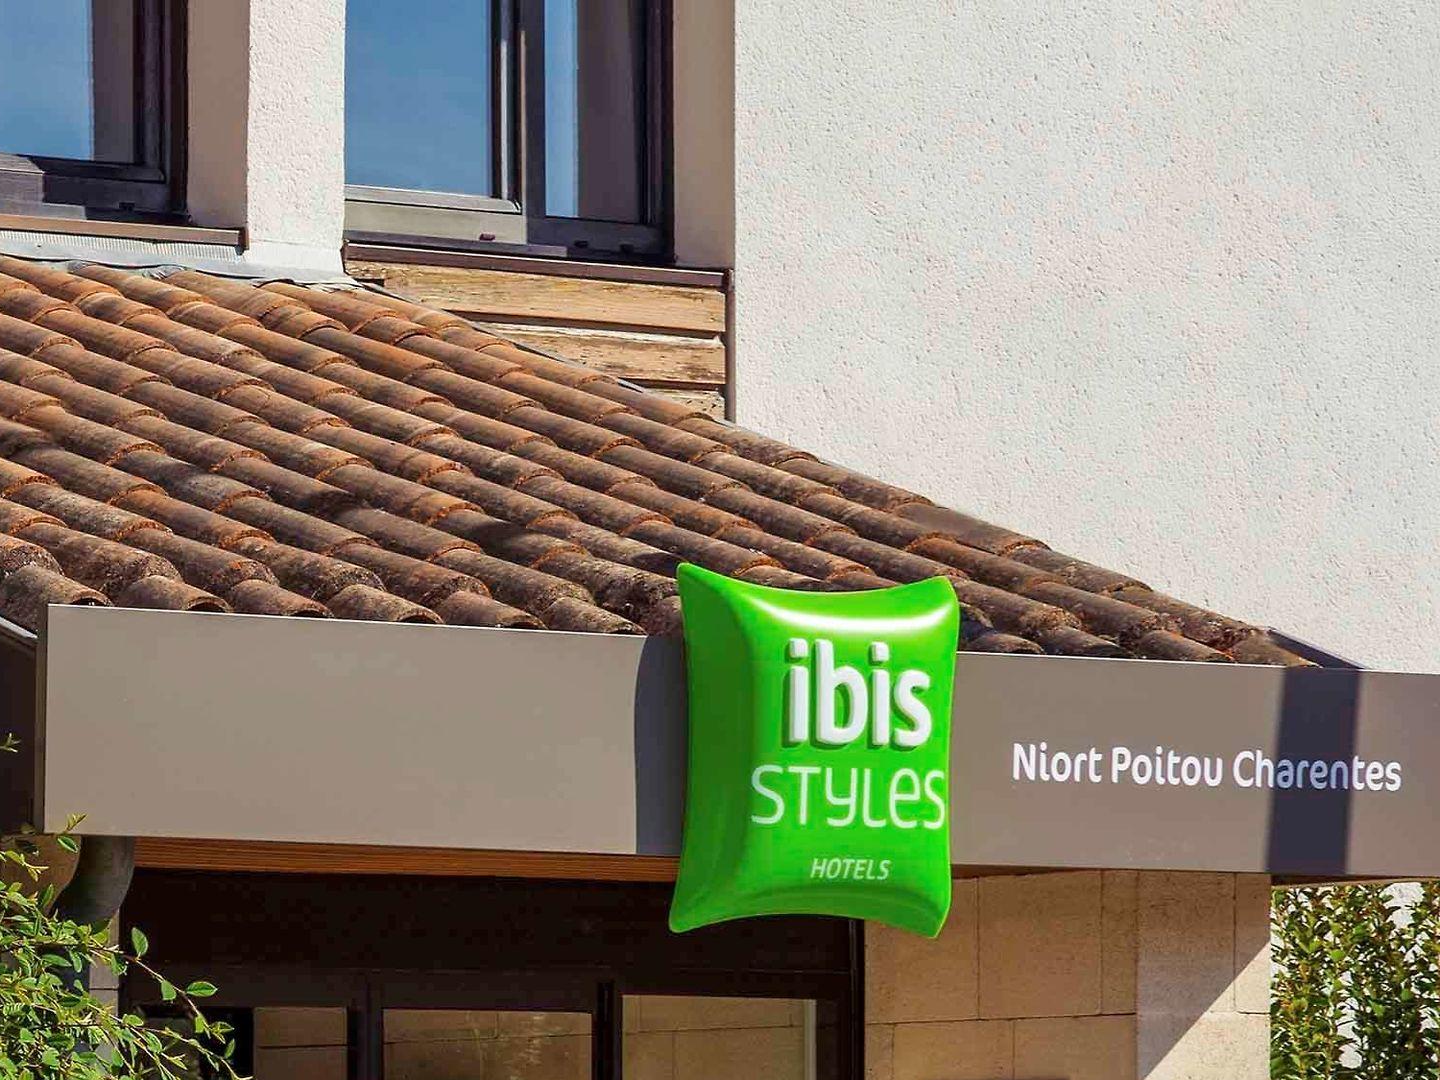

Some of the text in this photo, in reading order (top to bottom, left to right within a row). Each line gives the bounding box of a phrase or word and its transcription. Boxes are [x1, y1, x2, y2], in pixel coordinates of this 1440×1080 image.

[788, 637, 933, 747] ibis
[1013, 743, 1402, 793] Niort Poitou Charentes
[810, 857, 892, 882] HOTELS
